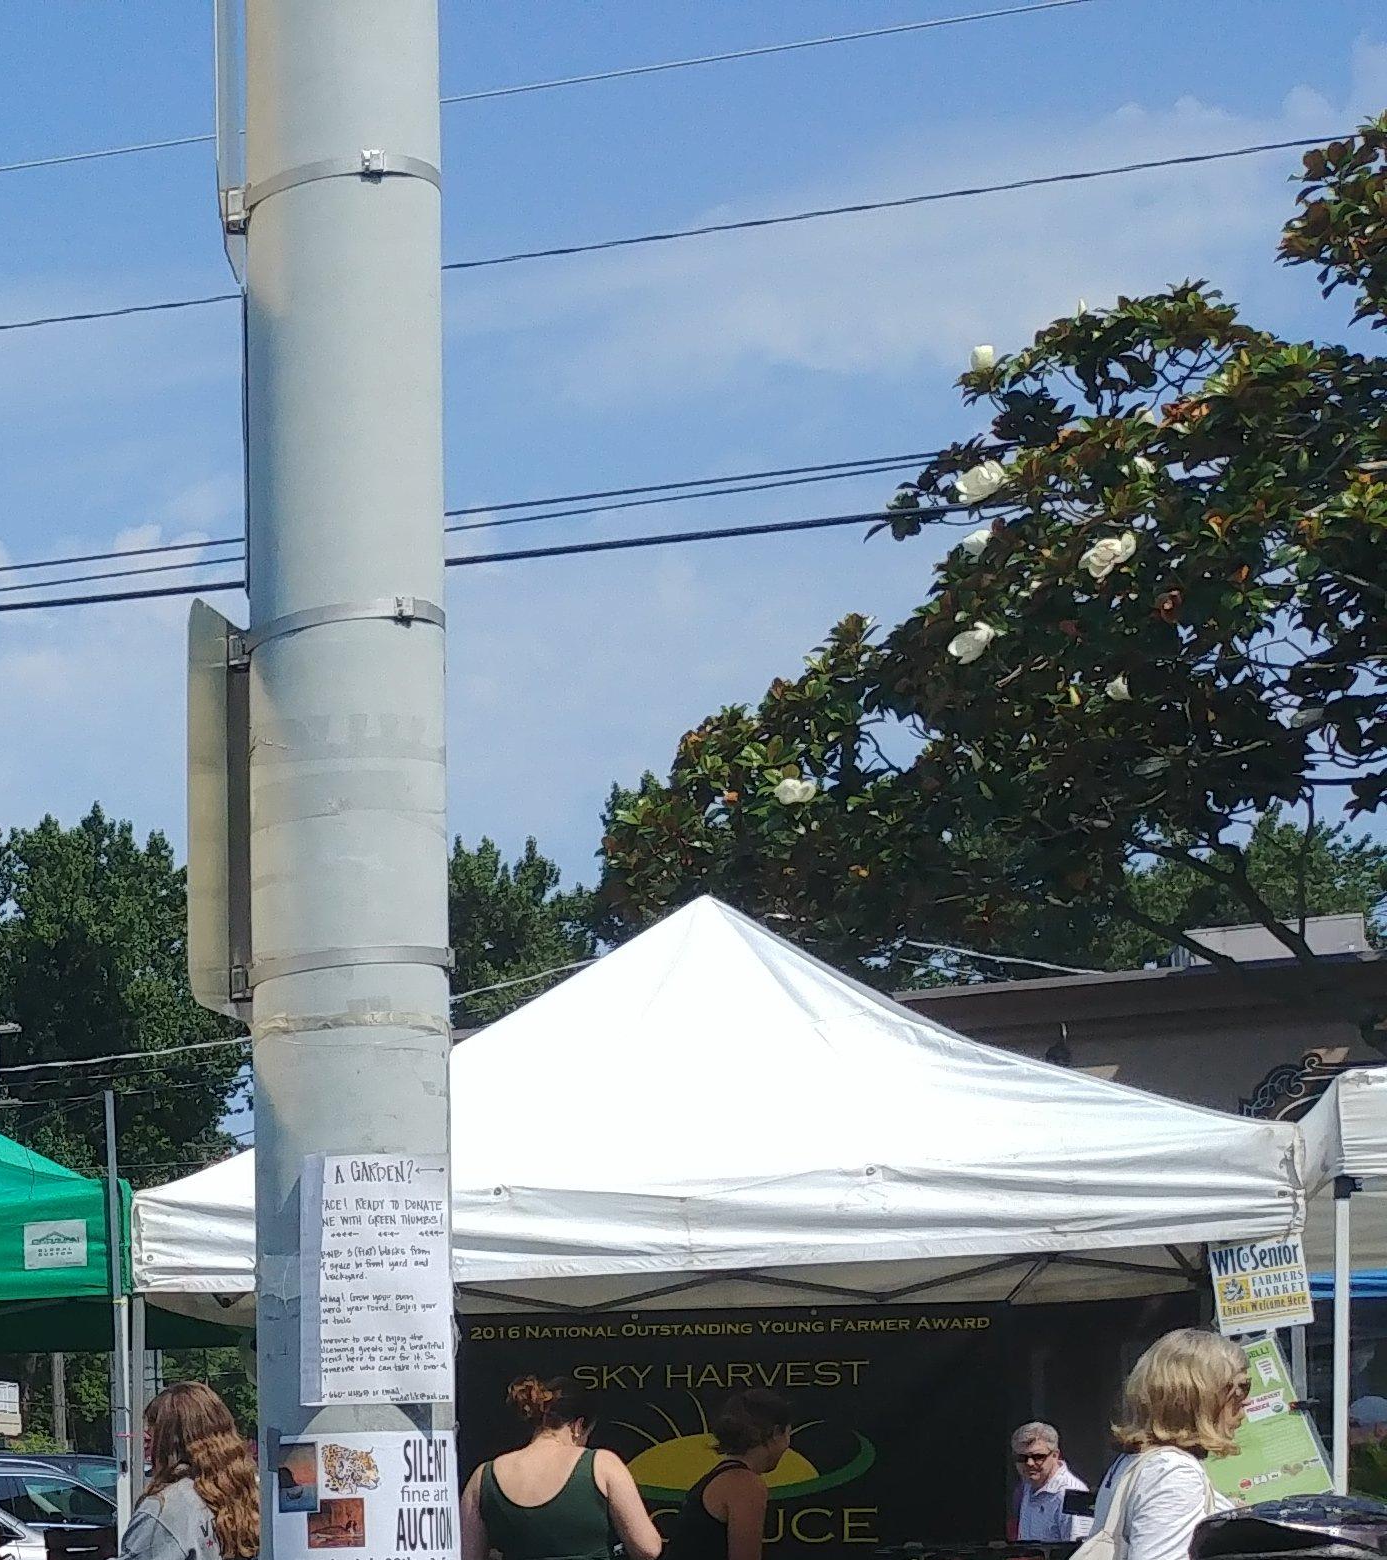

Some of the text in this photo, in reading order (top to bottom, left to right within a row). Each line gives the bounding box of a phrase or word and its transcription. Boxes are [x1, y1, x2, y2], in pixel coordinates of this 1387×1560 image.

[350, 1159, 415, 1184] GARDEN?
[322, 1197, 444, 1212] ACE! READY TO DONATE
[340, 1215, 363, 1226] WITH
[368, 1214, 397, 1228] GREEN
[1212, 1243, 1300, 1277] WIC Senior
[1251, 1269, 1305, 1288] FARMERS
[1253, 1280, 1306, 1299] MARKET
[470, 1325, 521, 1341] 2016
[572, 1360, 870, 1391] SKY HARVEST
[403, 1438, 448, 1483] SILENT
[400, 1485, 449, 1503] fine art
[395, 1506, 453, 1552] AUCTION
